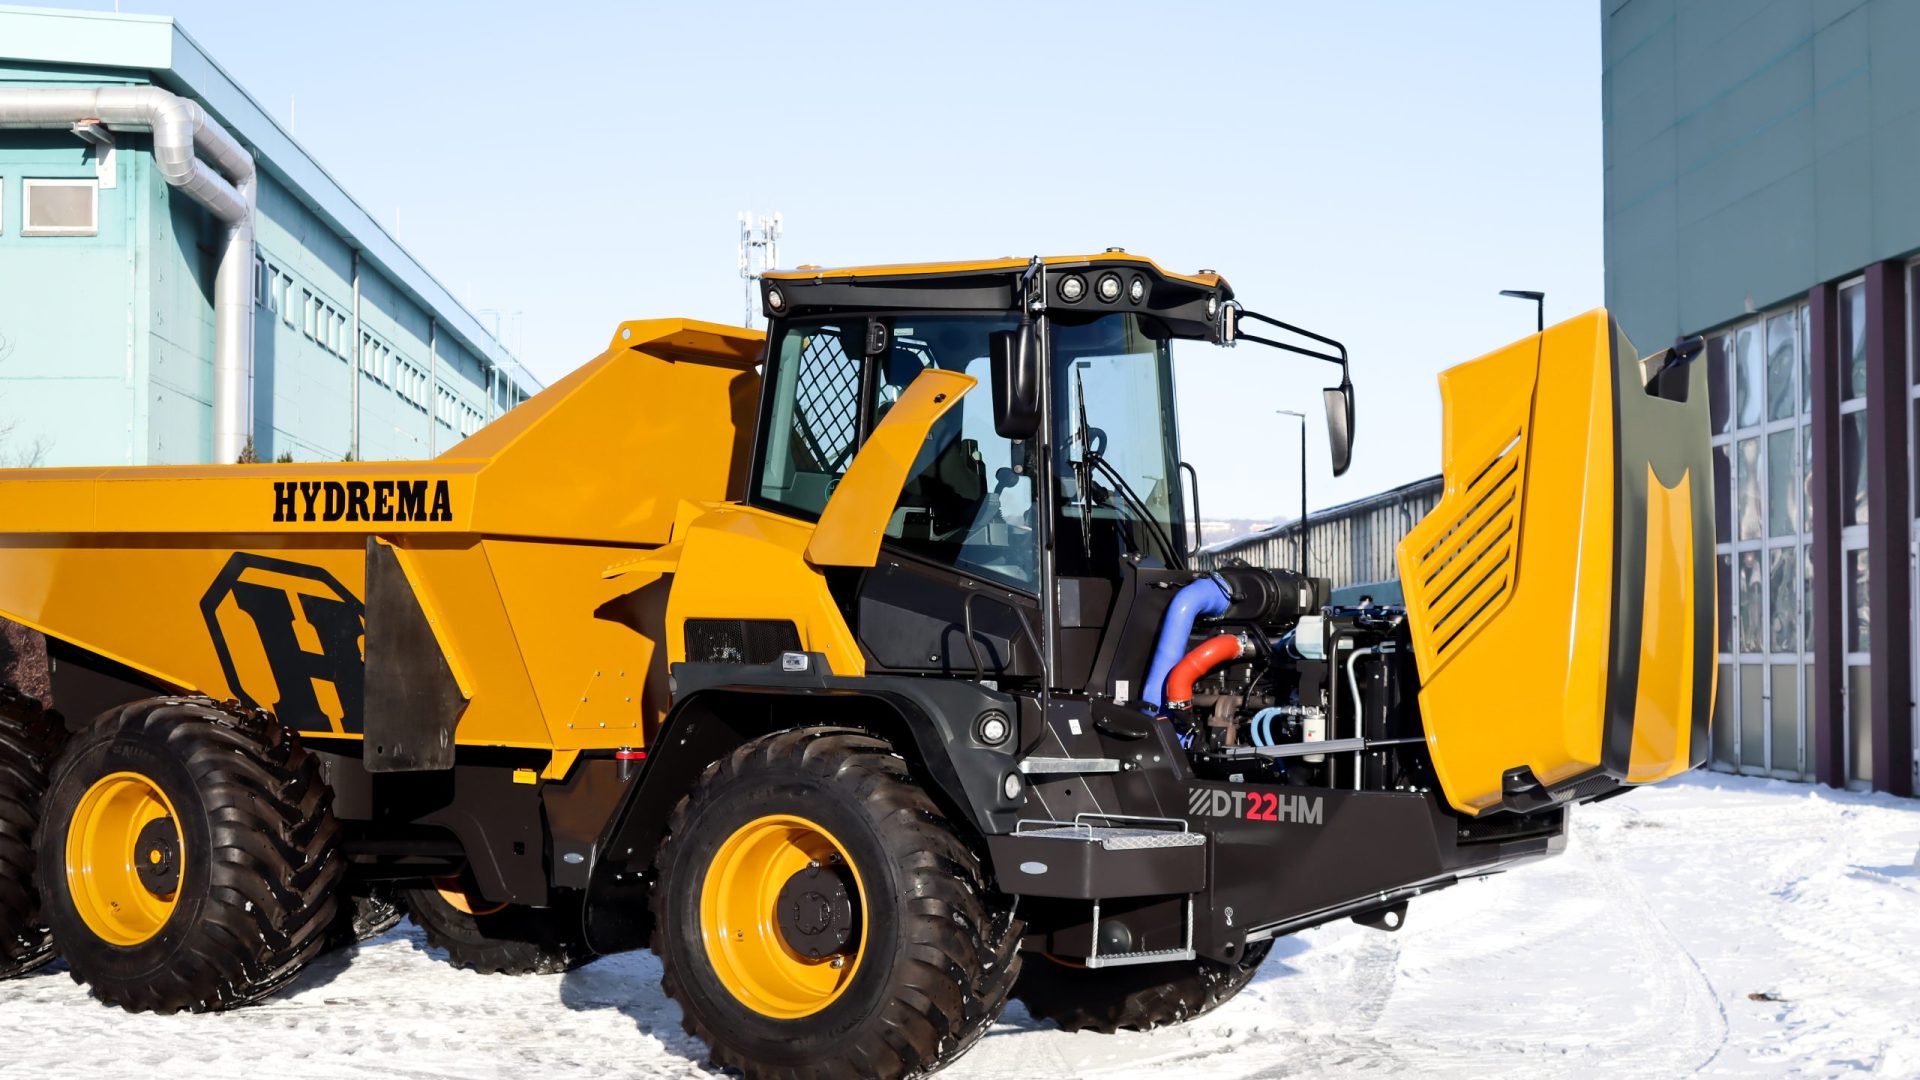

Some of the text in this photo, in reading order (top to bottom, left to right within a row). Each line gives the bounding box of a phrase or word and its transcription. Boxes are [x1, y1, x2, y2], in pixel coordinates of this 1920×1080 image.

[273, 480, 453, 522] HYDREMA
[230, 580, 365, 733] H
[1211, 789, 1324, 825] DT22HM
